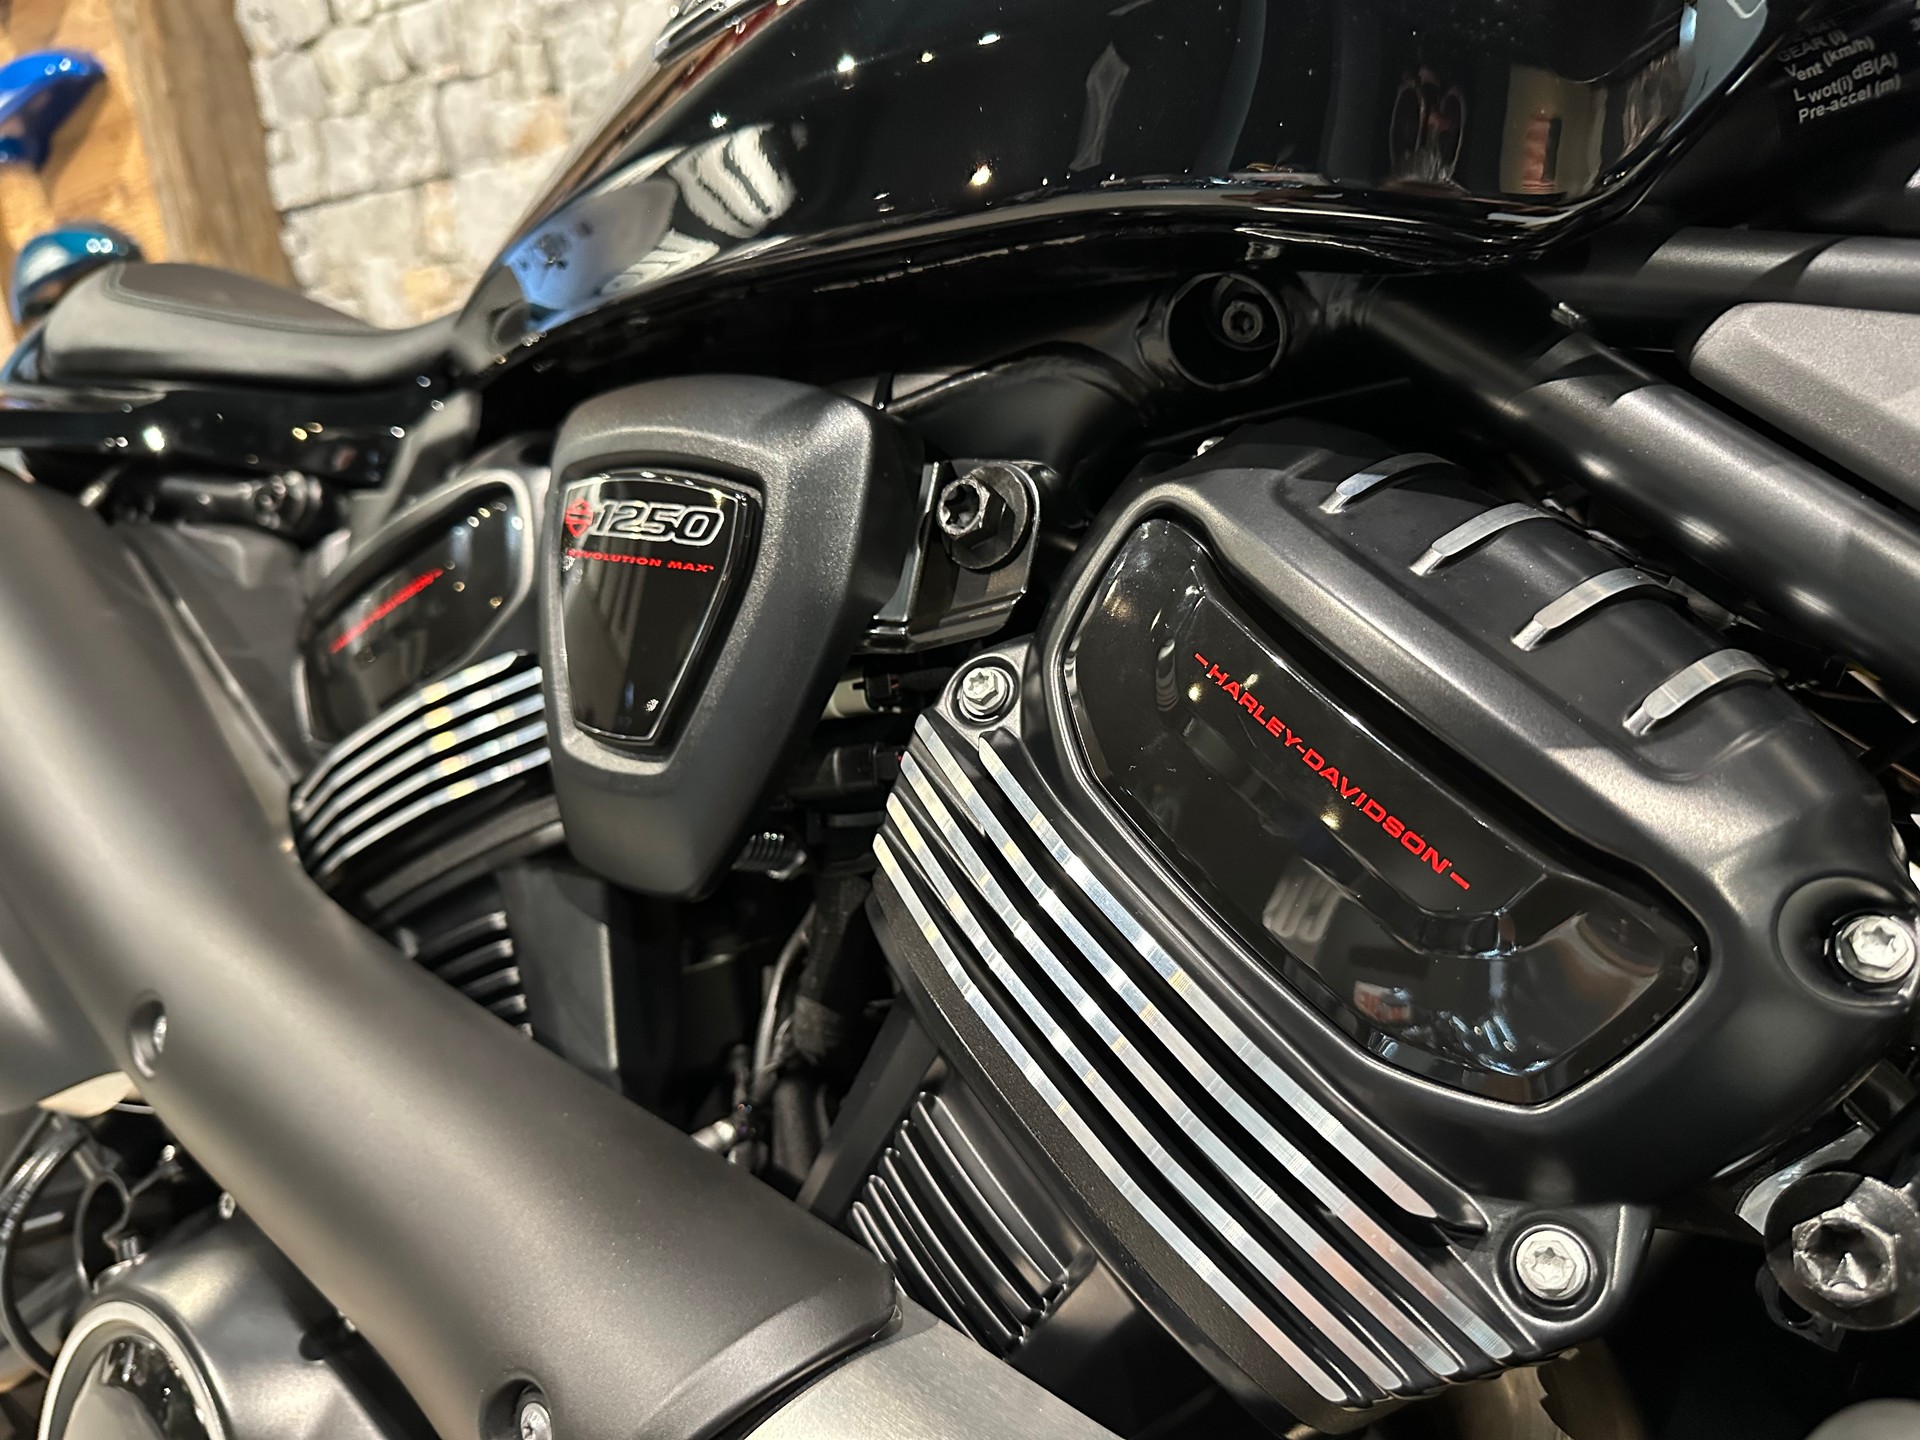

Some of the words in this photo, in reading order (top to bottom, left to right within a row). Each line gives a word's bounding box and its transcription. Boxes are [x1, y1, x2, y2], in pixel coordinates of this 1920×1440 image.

[1777, 36, 1829, 63] GEAR
[1784, 61, 1825, 81] Vent
[1822, 36, 1875, 67] (km/h)
[1852, 52, 1899, 80] dB(A)
[1798, 84, 1872, 124] Pre-accel
[1874, 73, 1902, 98] (m)
[590, 500, 725, 547] 1250
[667, 560, 711, 573] MAX
